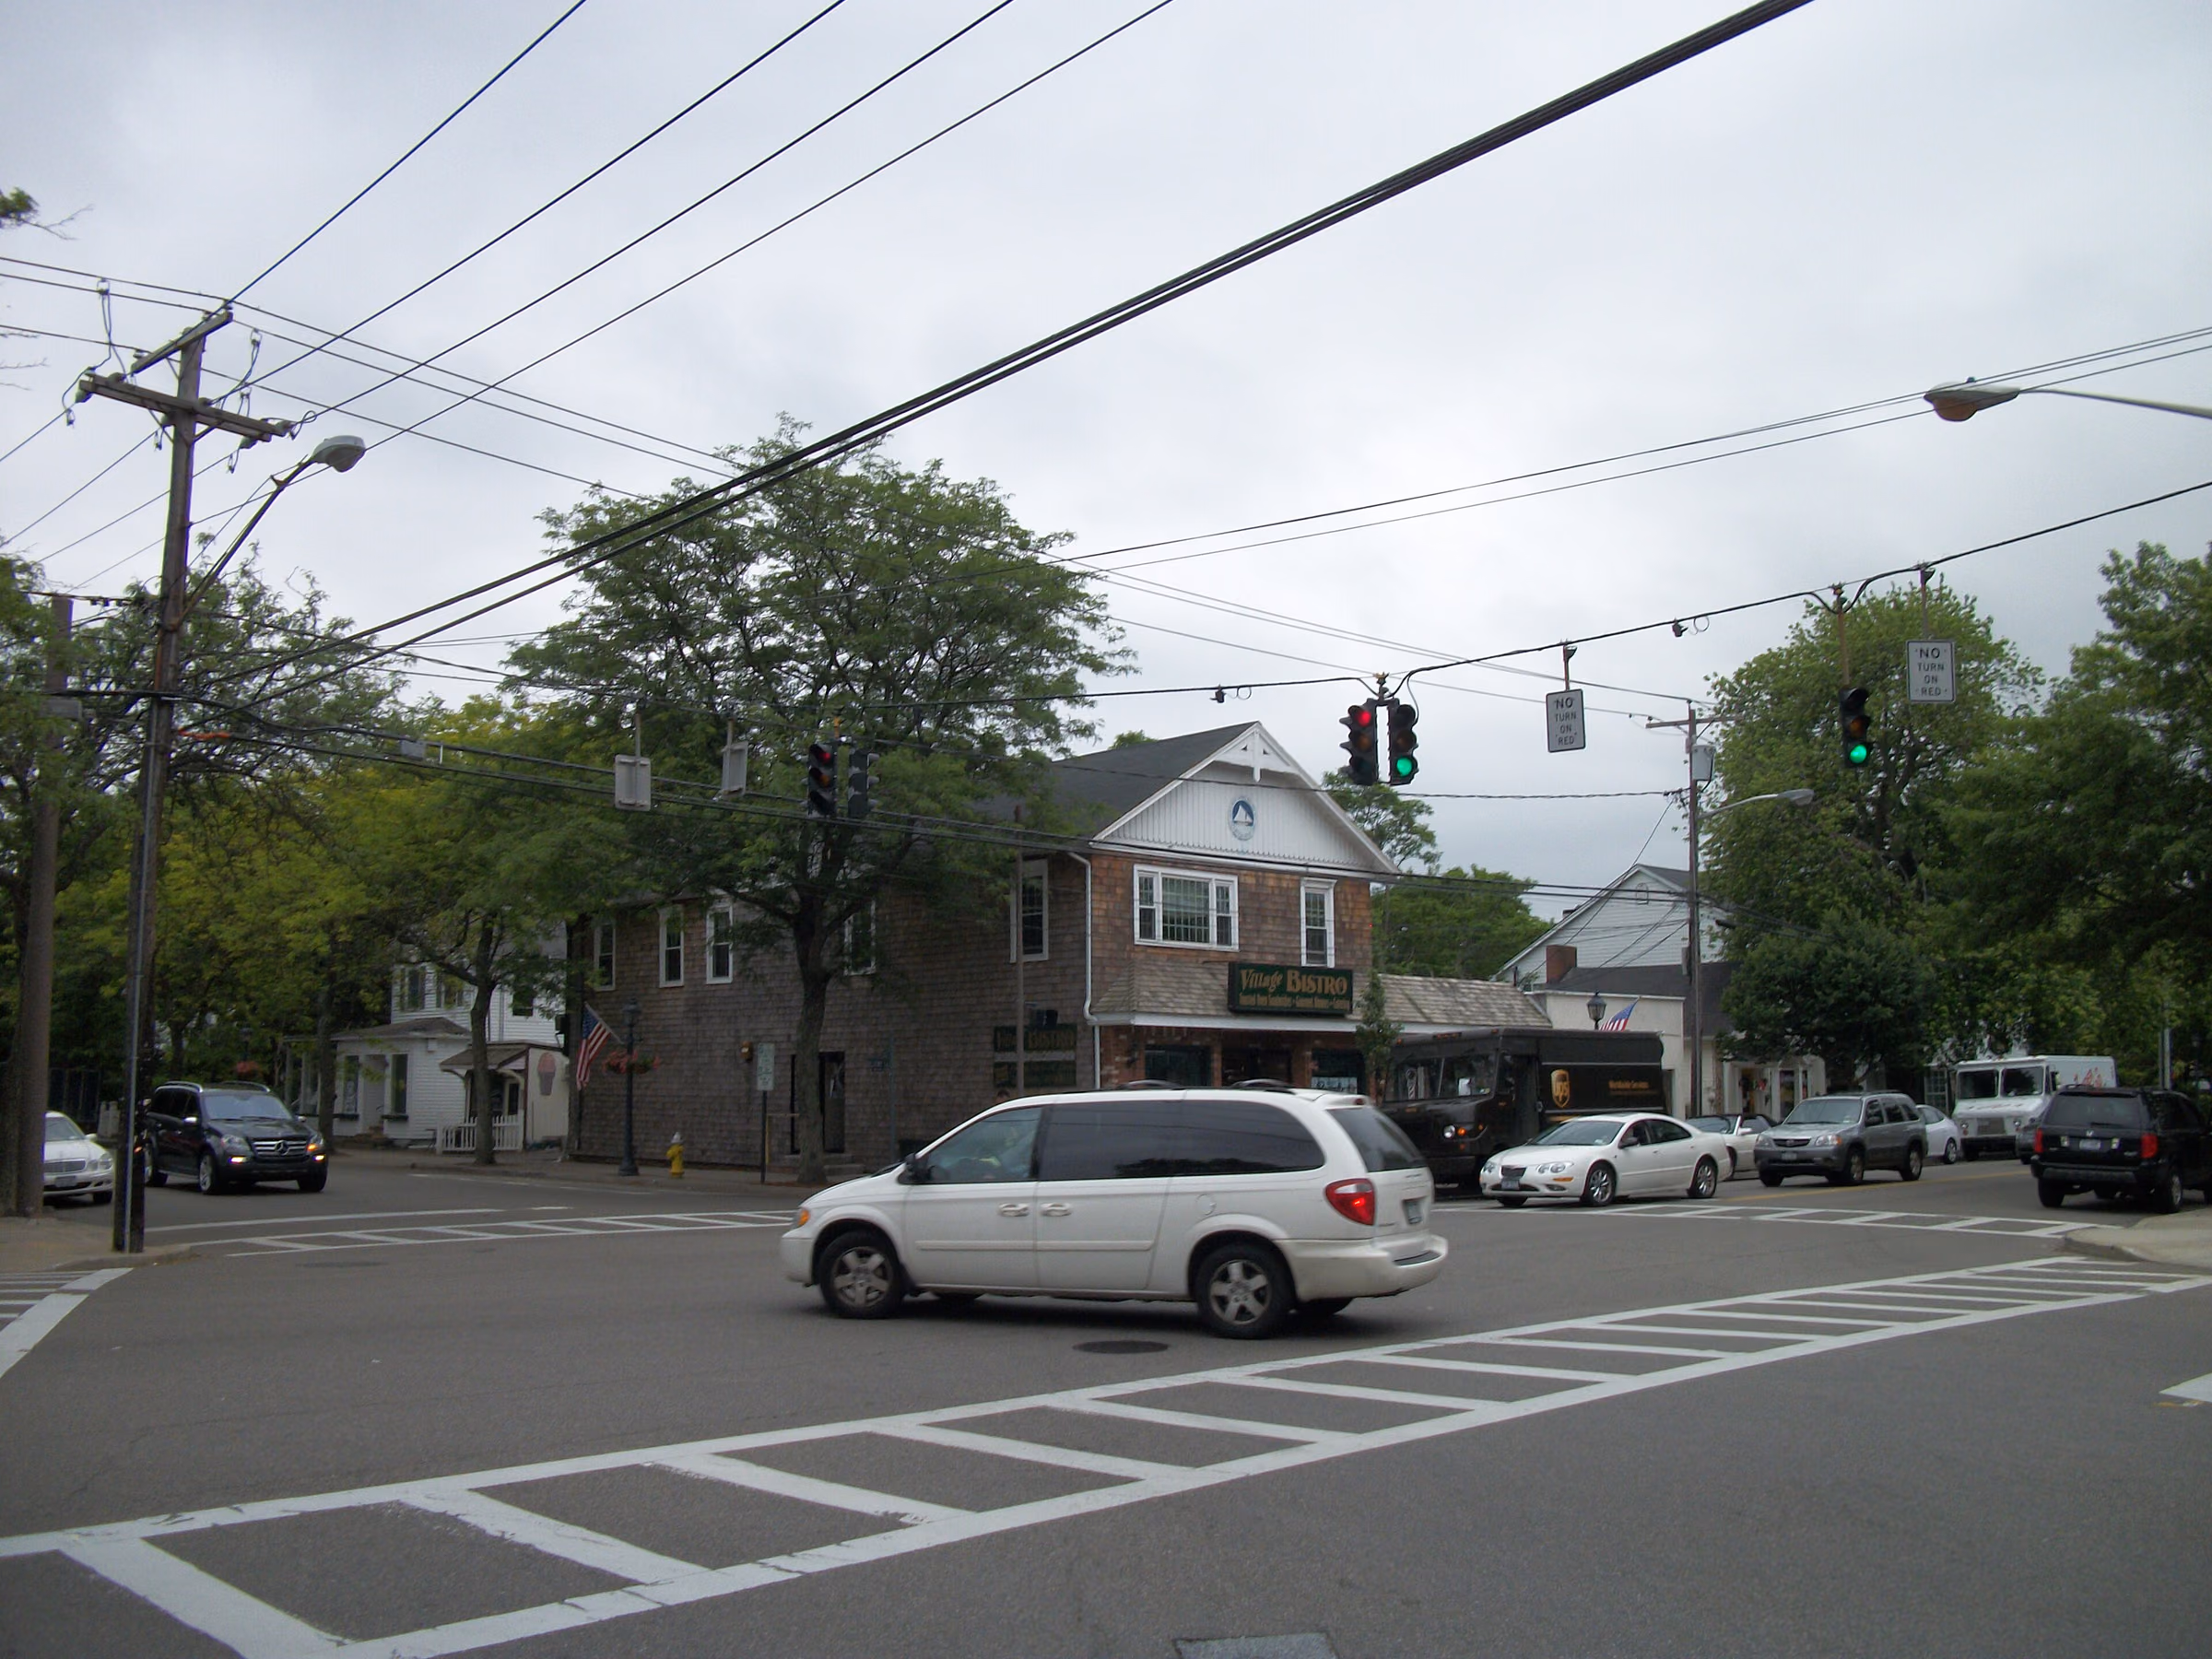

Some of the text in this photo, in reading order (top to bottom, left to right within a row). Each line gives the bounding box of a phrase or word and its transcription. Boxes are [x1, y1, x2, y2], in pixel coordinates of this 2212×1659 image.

[1920, 647, 1940, 659] NO
[1918, 663, 1944, 672] TURN
[1924, 675, 1937, 684] ON
[1921, 687, 1941, 696] RED
[1556, 697, 1573, 710] NO
[1555, 712, 1577, 723] TURN
[1559, 724, 1571, 734] ON
[1558, 735, 1574, 746] RED
[1240, 968, 1283, 993] Village
